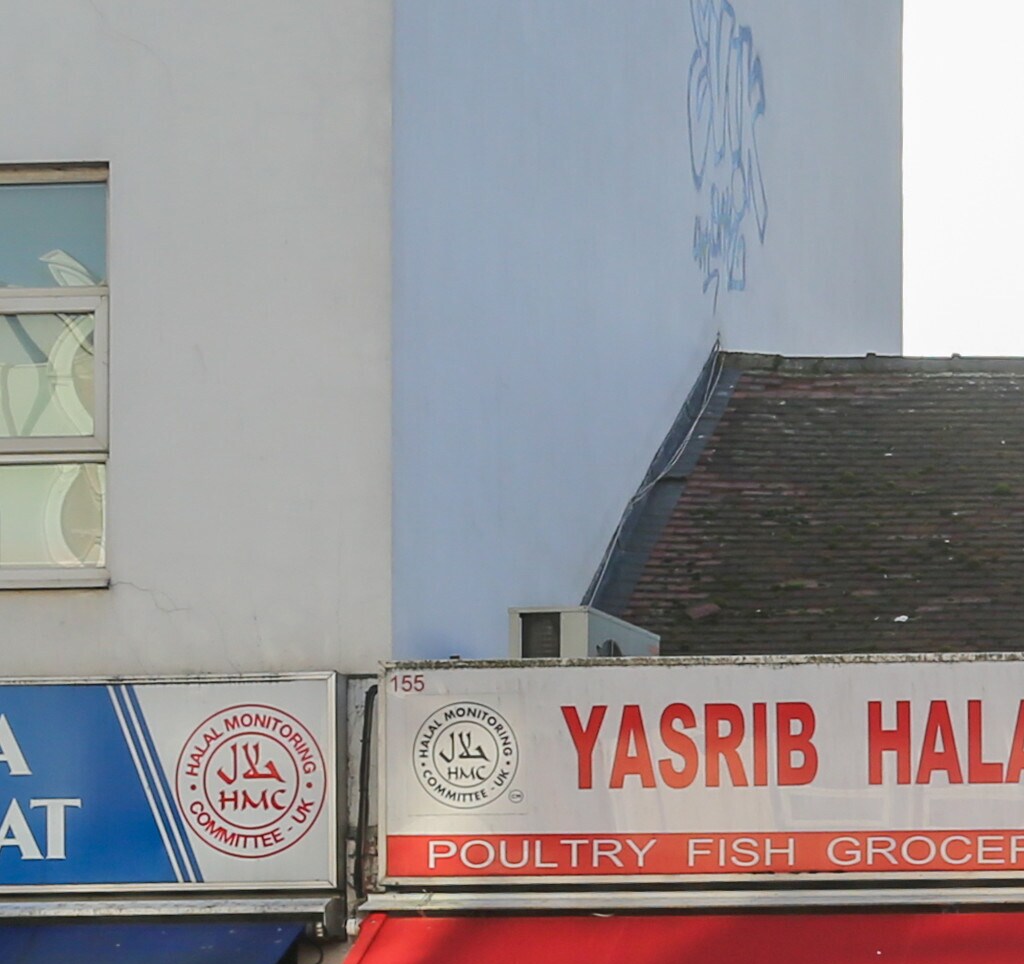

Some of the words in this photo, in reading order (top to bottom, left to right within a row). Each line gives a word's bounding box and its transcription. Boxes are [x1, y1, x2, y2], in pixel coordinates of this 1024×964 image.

[390, 675, 425, 693] 155
[185, 727, 224, 777] HALAL
[223, 713, 317, 775] MONITORING
[419, 719, 443, 758] HALAL
[444, 707, 513, 757] MONITORING
[438, 731, 491, 763] حلال
[561, 702, 819, 790] YASRIB
[216, 742, 286, 785] حلال
[447, 765, 486, 781] HMC
[218, 789, 286, 811] HMC
[422, 769, 488, 803] COMMITTEE
[494, 768, 510, 787] UK
[0, 797, 82, 860] AT
[189, 801, 286, 849] COMMITTEE
[291, 798, 315, 825] UK
[427, 839, 657, 869] POULTRY
[687, 837, 796, 868] FISH
